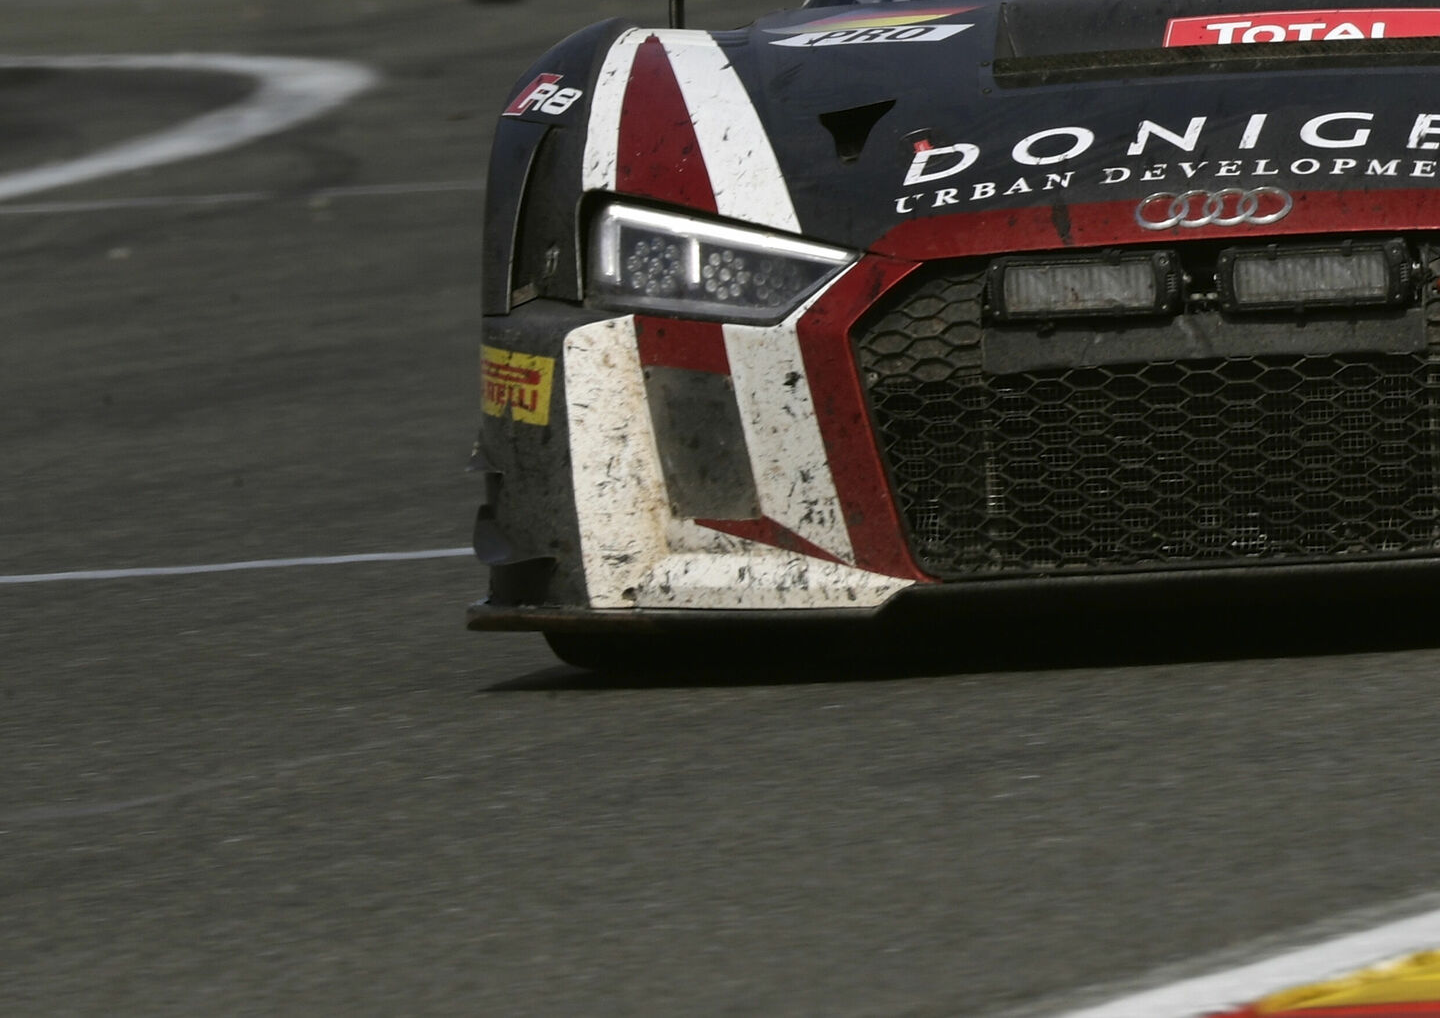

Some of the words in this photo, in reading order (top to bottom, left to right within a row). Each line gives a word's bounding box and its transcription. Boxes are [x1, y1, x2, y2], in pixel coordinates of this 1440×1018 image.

[803, 26, 937, 45] PRO
[517, 82, 583, 115] R8
[895, 171, 1075, 213] URBAN
